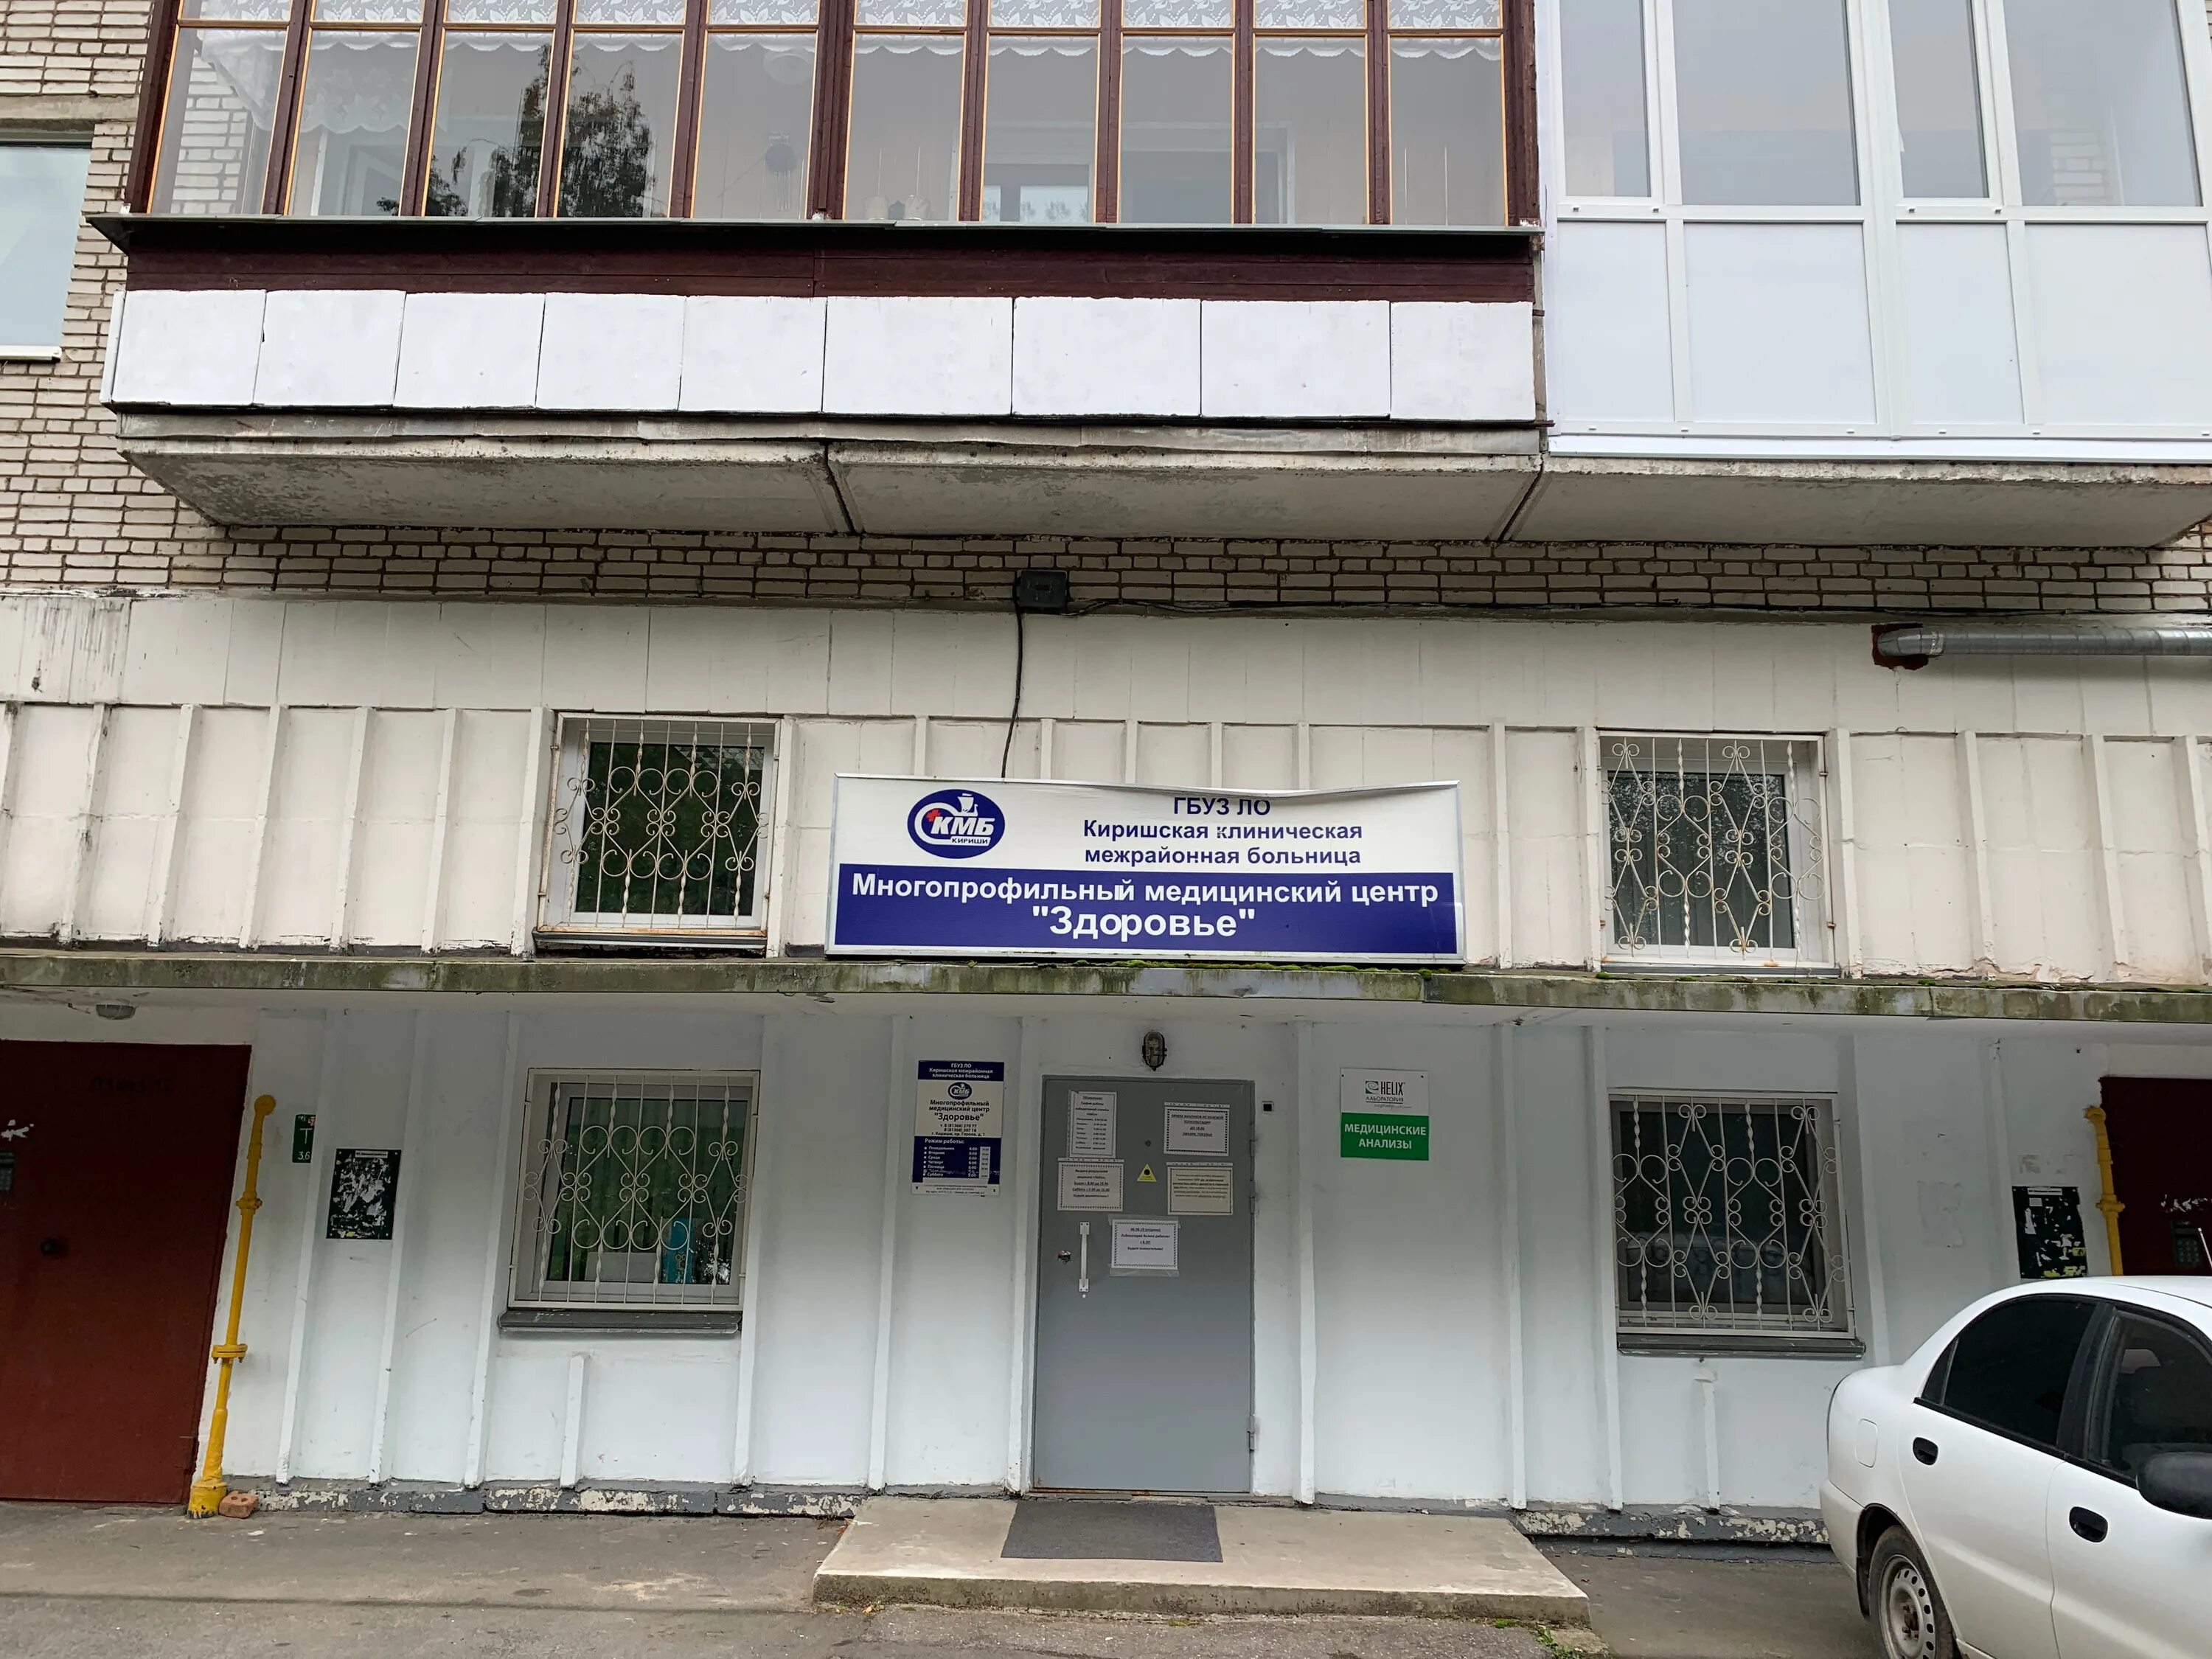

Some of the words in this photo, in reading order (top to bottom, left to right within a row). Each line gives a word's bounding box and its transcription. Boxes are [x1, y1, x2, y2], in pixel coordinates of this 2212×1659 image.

[1173, 797, 1230, 815] ГБУЗ
[1237, 799, 1271, 815] ЛО
[931, 816, 995, 836] КМБ
[1083, 819, 1209, 841] Киришская
[1216, 824, 1363, 840] клиническая
[1085, 846, 1239, 867] межрайонная
[1248, 846, 1361, 866] больница
[852, 872, 1135, 904] Многопрофильный
[1144, 880, 1342, 905] медицинский
[1351, 884, 1439, 908] центр
[1032, 905, 1256, 942] "Здоровье"
[1380, 1081, 1404, 1096] HELIX
[934, 1113, 984, 1121] "Здоровье"
[1344, 1124, 1427, 1135] МЕДИЦИНСКИЕ
[1358, 1138, 1412, 1150] АНАЛИЗЫ
